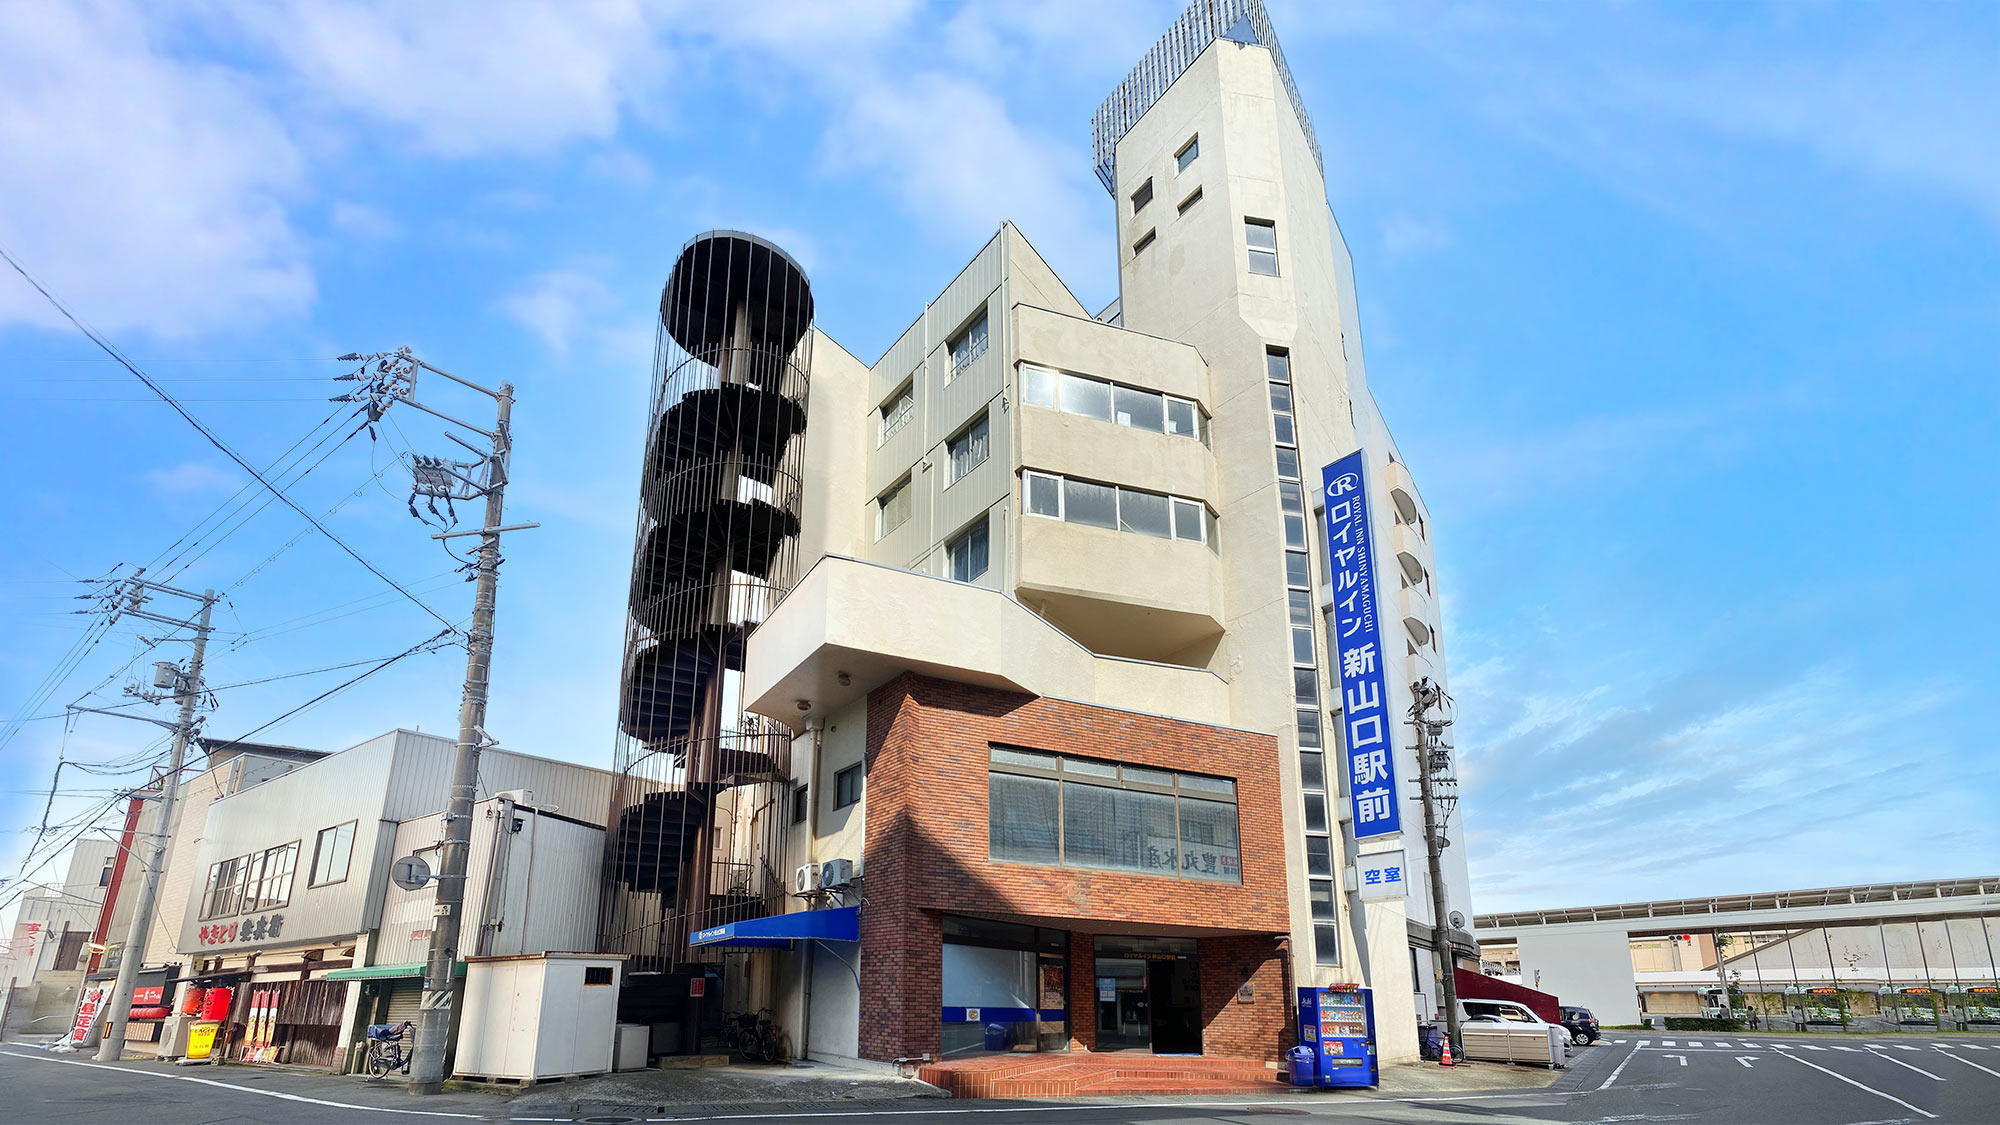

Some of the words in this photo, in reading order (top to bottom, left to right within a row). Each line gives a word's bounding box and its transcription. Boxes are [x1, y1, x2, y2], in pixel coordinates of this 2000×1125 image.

[1352, 495, 1363, 527] ROYAL
[1355, 528, 1365, 545] INN
[1330, 500, 1362, 638] ロイヤルイン
[1357, 545, 1374, 633] SHINYAMAGUCHI
[1343, 641, 1392, 824] 新山口駅前
[1364, 866, 1402, 886] 空室
[198, 922, 238, 946] やきとり
[72, 1002, 96, 1041] 昼定食
